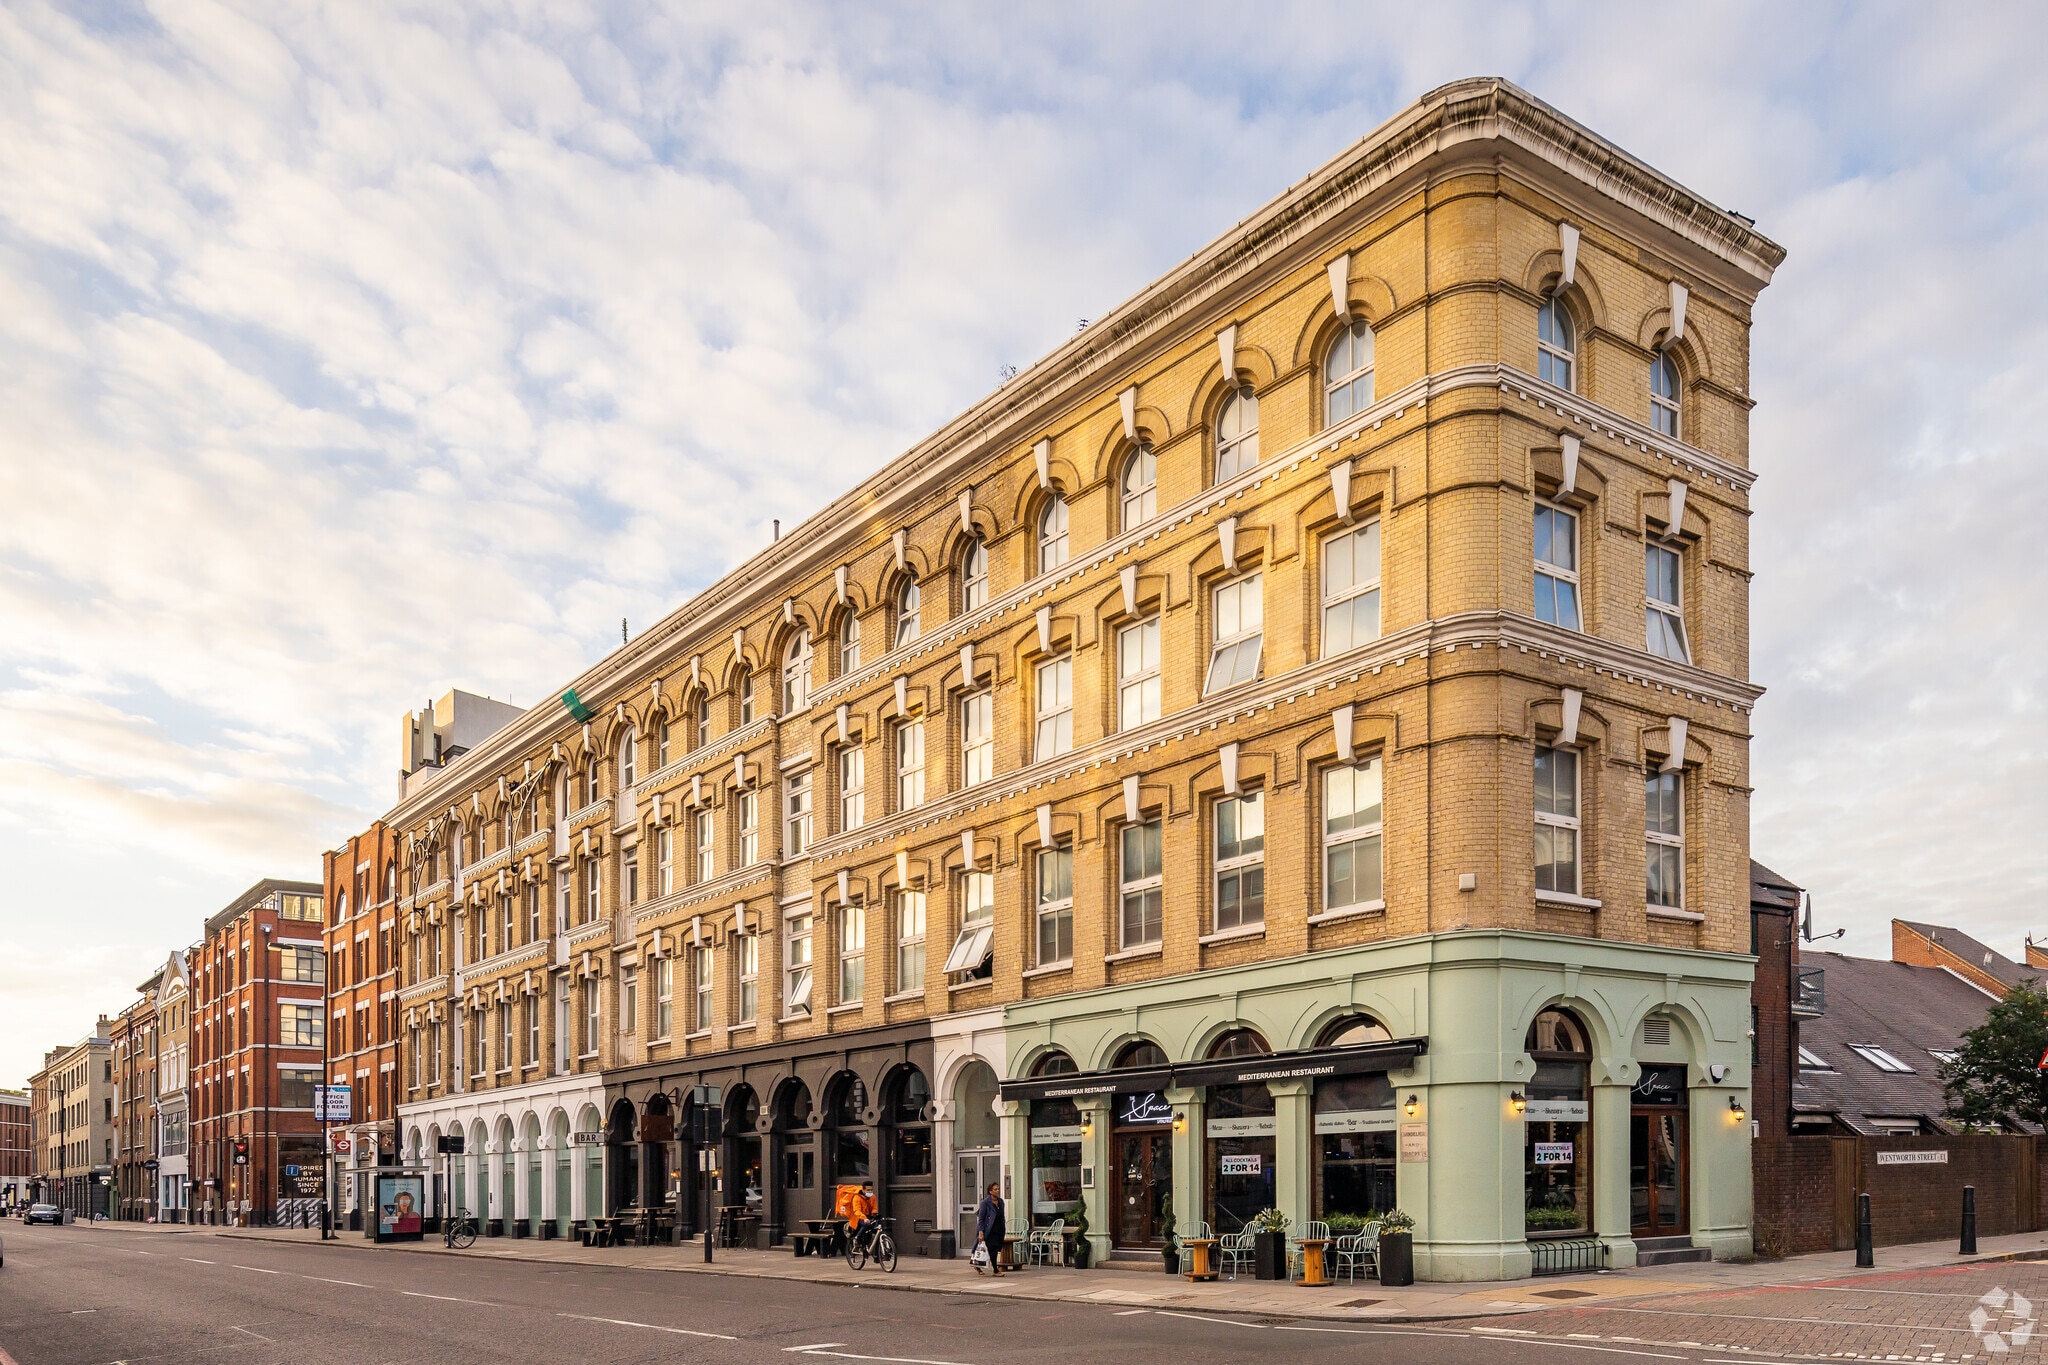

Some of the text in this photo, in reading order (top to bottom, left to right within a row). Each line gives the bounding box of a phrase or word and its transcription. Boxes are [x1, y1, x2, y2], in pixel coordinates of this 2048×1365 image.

[1238, 1066, 1335, 1081] MEDITERRANEAN RESTAURANT
[1045, 1086, 1116, 1097] MEDITERRANEAN RESTAURANT
[1120, 1093, 1171, 1119] Space
[1536, 1153, 1571, 1161] 2 FOR 14
[1917, 1153, 1937, 1161] STREET
[1230, 1164, 1248, 1172] FOR
